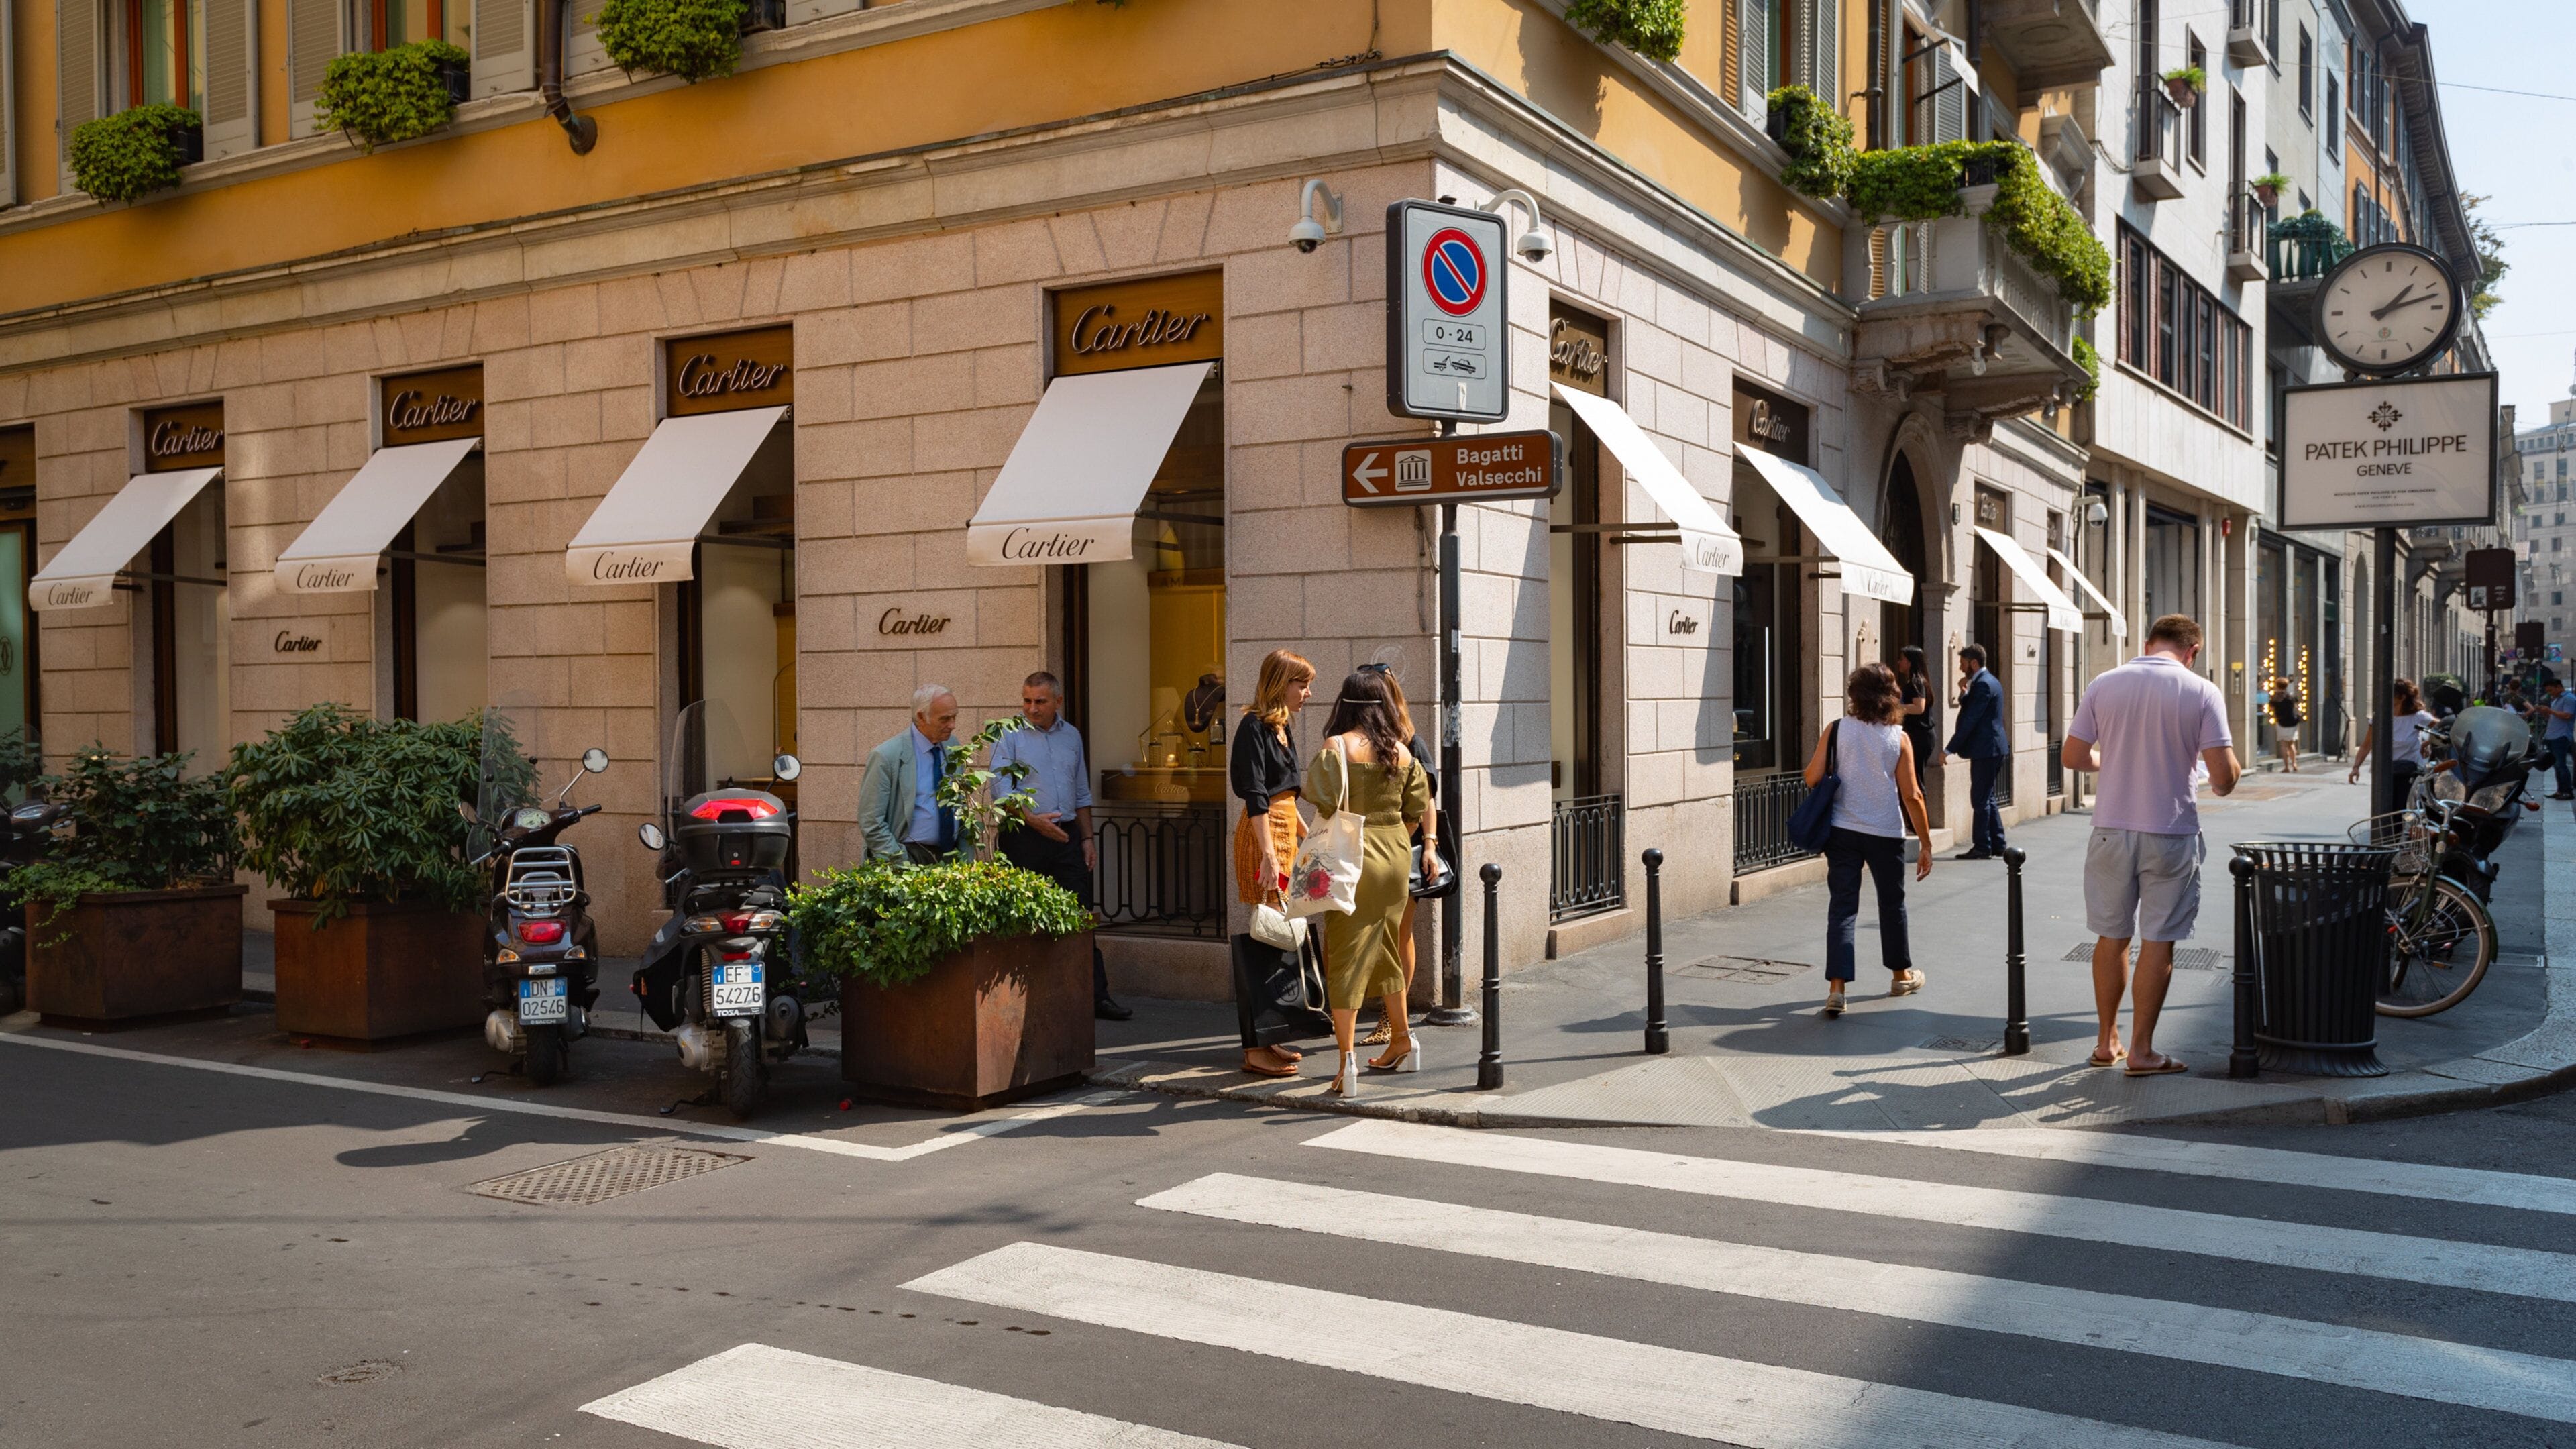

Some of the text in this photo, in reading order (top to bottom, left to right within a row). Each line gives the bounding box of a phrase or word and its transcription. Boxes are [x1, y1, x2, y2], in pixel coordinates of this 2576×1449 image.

[1071, 303, 1208, 354] Cartier
[1436, 327, 1444, 339] 0
[1456, 329, 1473, 343] 24
[1549, 317, 1607, 375] Cartier
[678, 354, 784, 397] Cartier
[390, 390, 478, 429] Cartier
[1752, 398, 1790, 443] Cartier
[152, 421, 223, 457] Cartier
[2306, 435, 2467, 461] PATEK PHILIPPE
[1457, 445, 1523, 466] Bagatti
[1456, 468, 1541, 487] Valsecchi
[2357, 463, 2412, 476] GENEVE
[1002, 527, 1094, 559] Cartier
[1696, 537, 1729, 568] Cartier
[297, 564, 354, 588] Cartier
[594, 551, 663, 579] Cartier
[48, 583, 93, 606] Cartier
[879, 608, 950, 635] Cartier
[1670, 610, 1698, 635] Cartier
[274, 630, 322, 653] Cartier
[726, 967, 743, 982] EF
[531, 981, 547, 996] DN
[716, 987, 761, 1005] 54276
[523, 999, 564, 1016] 02546
[716, 1008, 739, 1016] TOSA
